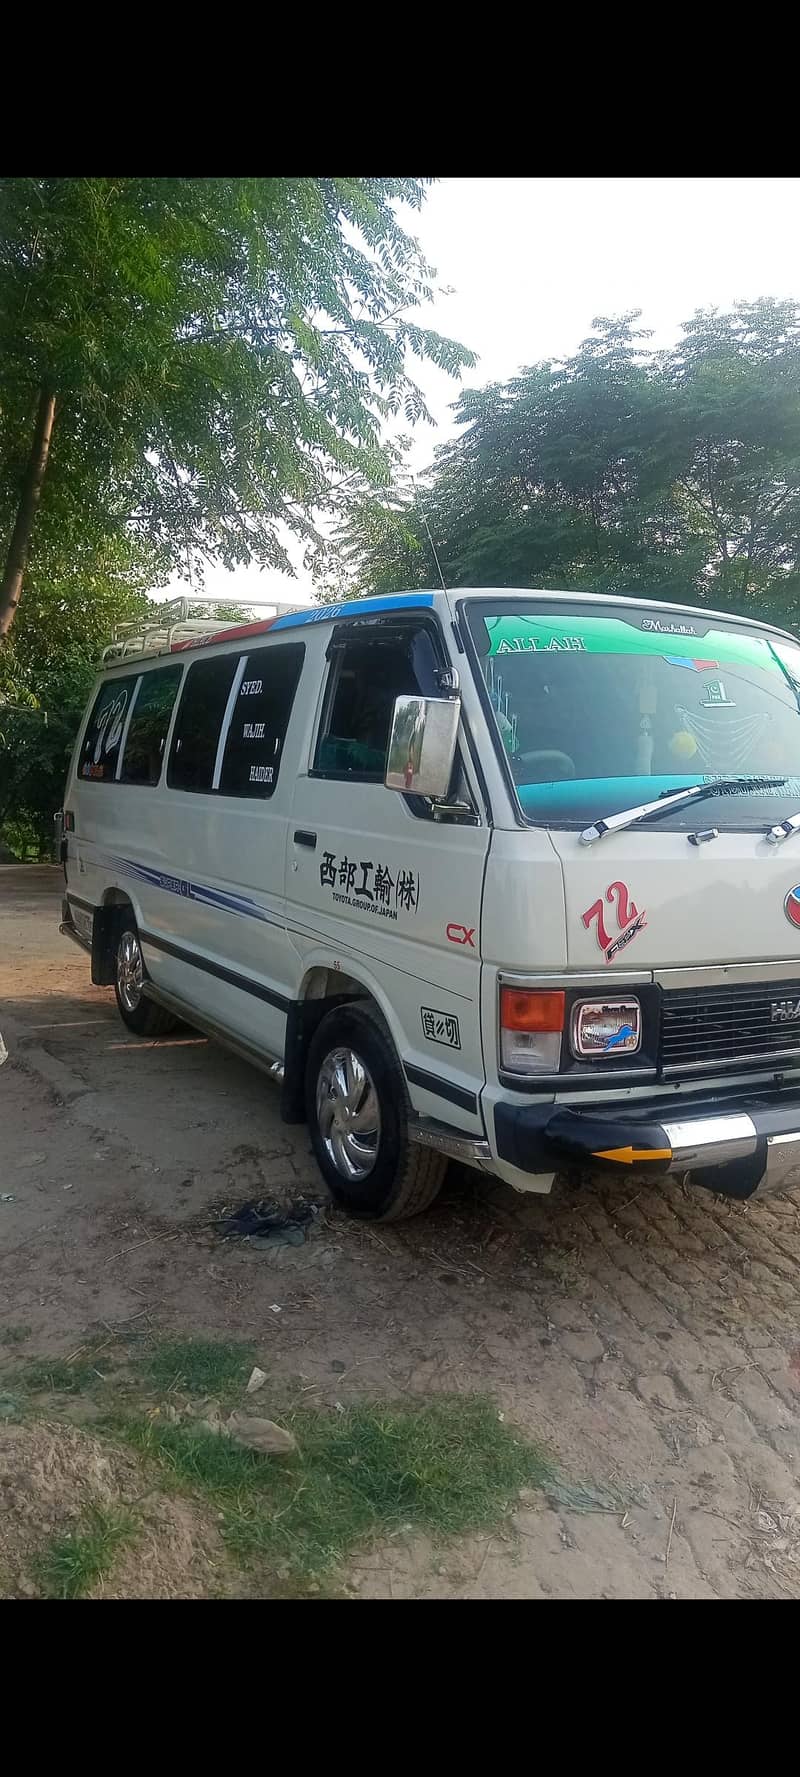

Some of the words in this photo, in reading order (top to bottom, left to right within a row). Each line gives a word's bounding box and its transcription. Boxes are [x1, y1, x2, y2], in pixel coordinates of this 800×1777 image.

[496, 636, 587, 654] ALLAH
[249, 765, 274, 783] HAIDER
[581, 880, 639, 950] 72
[446, 923, 476, 947] CX
